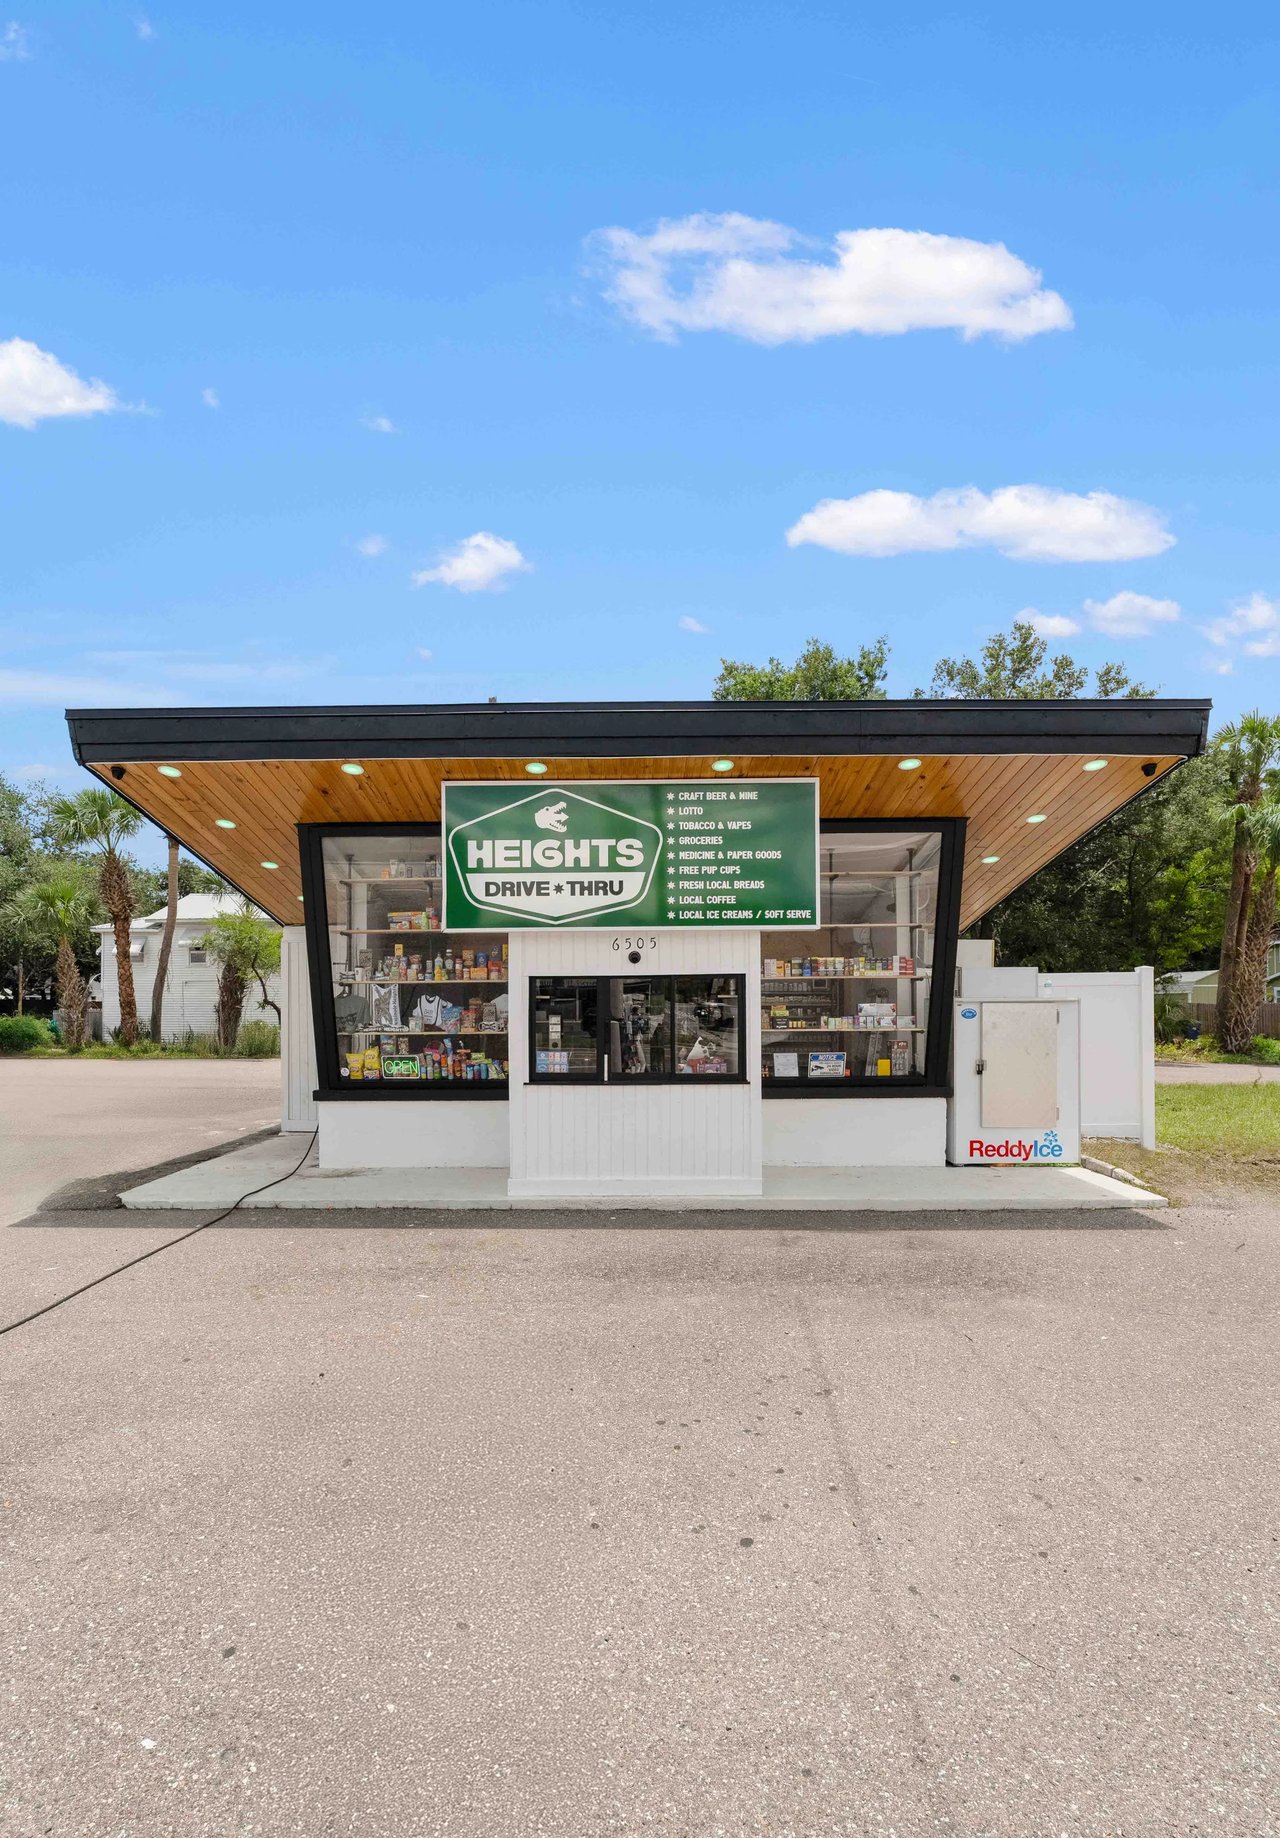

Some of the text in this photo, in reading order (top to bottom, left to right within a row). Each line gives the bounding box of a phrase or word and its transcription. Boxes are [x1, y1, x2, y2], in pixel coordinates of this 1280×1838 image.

[679, 792, 758, 800] CRAFT BEER & WINE
[679, 807, 703, 815] LOTTO
[679, 821, 752, 830] TOBACCO & VAPES
[679, 836, 723, 845] GROCERIES
[467, 838, 645, 868] HEIGHTS
[679, 851, 782, 860] MEDICINE & PAPER GOODS
[679, 866, 740, 874] FREE PUP CUPS
[484, 880, 624, 897] DRIVE THRU
[679, 881, 765, 889] FRESH LOCAL BREADS
[679, 895, 736, 904] LOCAL COFFEE
[679, 910, 811, 919] LOCAL ICE CREAMS / SOFT SERVE
[612, 937, 656, 951] 6505
[384, 1060, 418, 1074] OPEN
